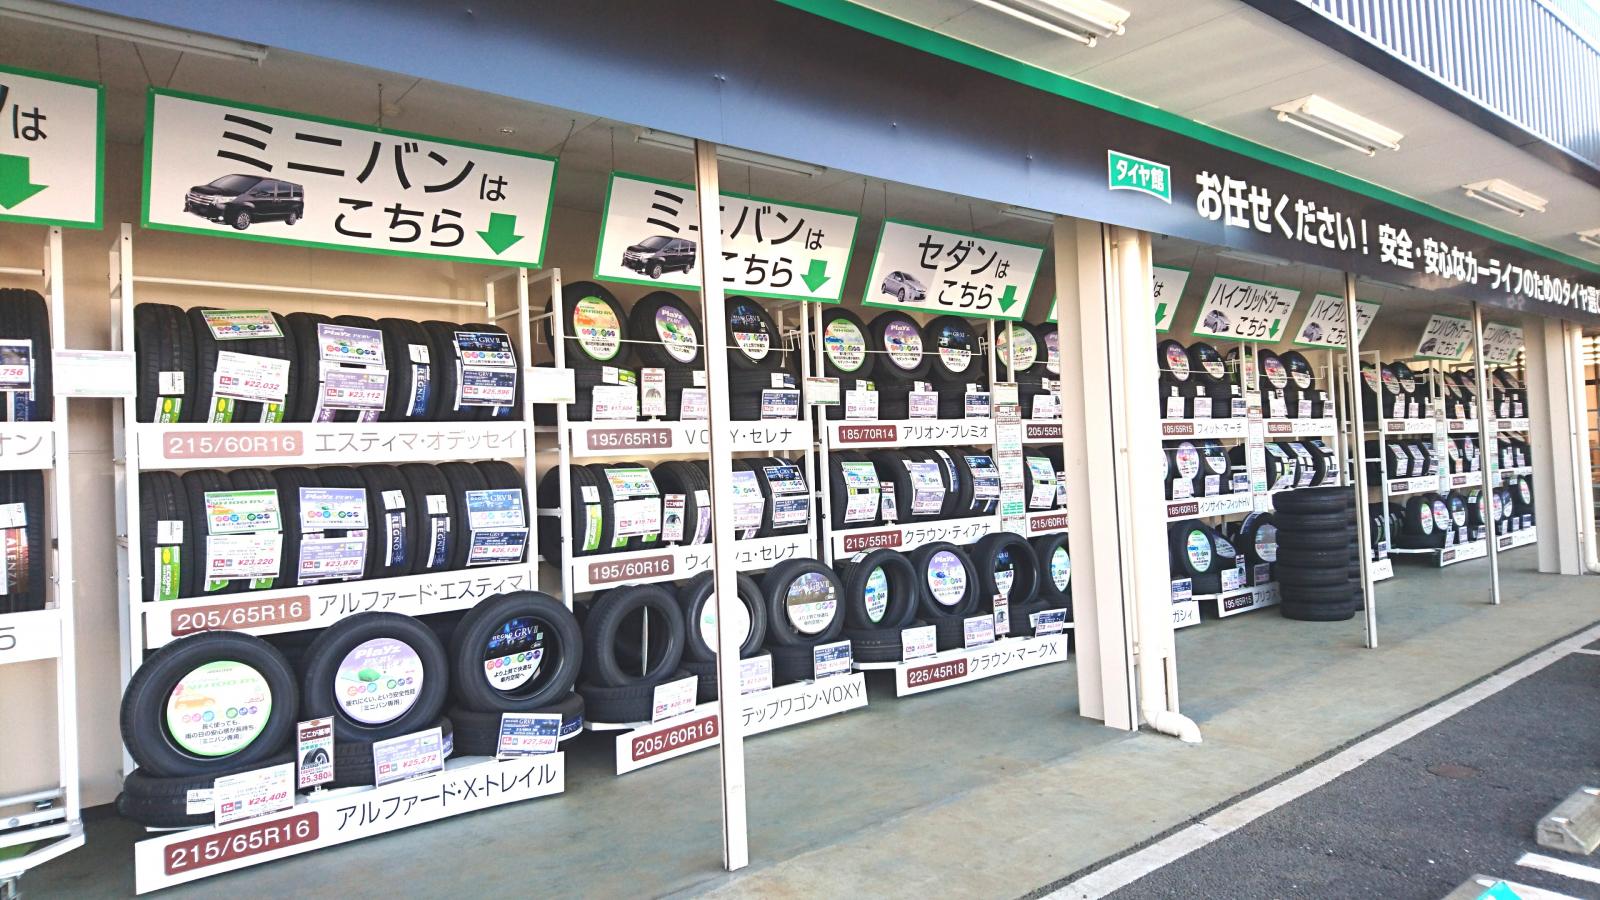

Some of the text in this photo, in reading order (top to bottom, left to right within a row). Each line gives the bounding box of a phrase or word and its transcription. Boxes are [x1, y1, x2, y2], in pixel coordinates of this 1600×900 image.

[217, 113, 508, 201] ミニバンは
[1115, 159, 1165, 192] タイヤ館
[334, 197, 465, 247] こちら
[918, 234, 1010, 278] セダンは
[938, 280, 994, 309] こちら
[1211, 283, 1290, 315] ハイブリッドカーは
[1235, 316, 1268, 337] こちら
[244, 379, 281, 390] ¥22,032
[169, 430, 518, 454] 215/60R16 エスティマ・オデッセイ
[591, 433, 668, 446] 195/65R15
[841, 425, 989, 440] 185/70R14 アリオン・プレミオ
[1028, 426, 1063, 436] 205/55R1
[846, 523, 991, 549] 215/55R17 クラウン・ティアナ
[238, 558, 274, 566] ¥23,220
[592, 559, 670, 580] 195/60R16
[177, 575, 524, 631] 205/65R16 アルファード・エスティマ
[909, 641, 1057, 684] 225/45R18 クラウン・マークX
[635, 681, 862, 757] 205/60R16 テップワゴン・VOXY
[171, 819, 310, 869] 215/65R16
